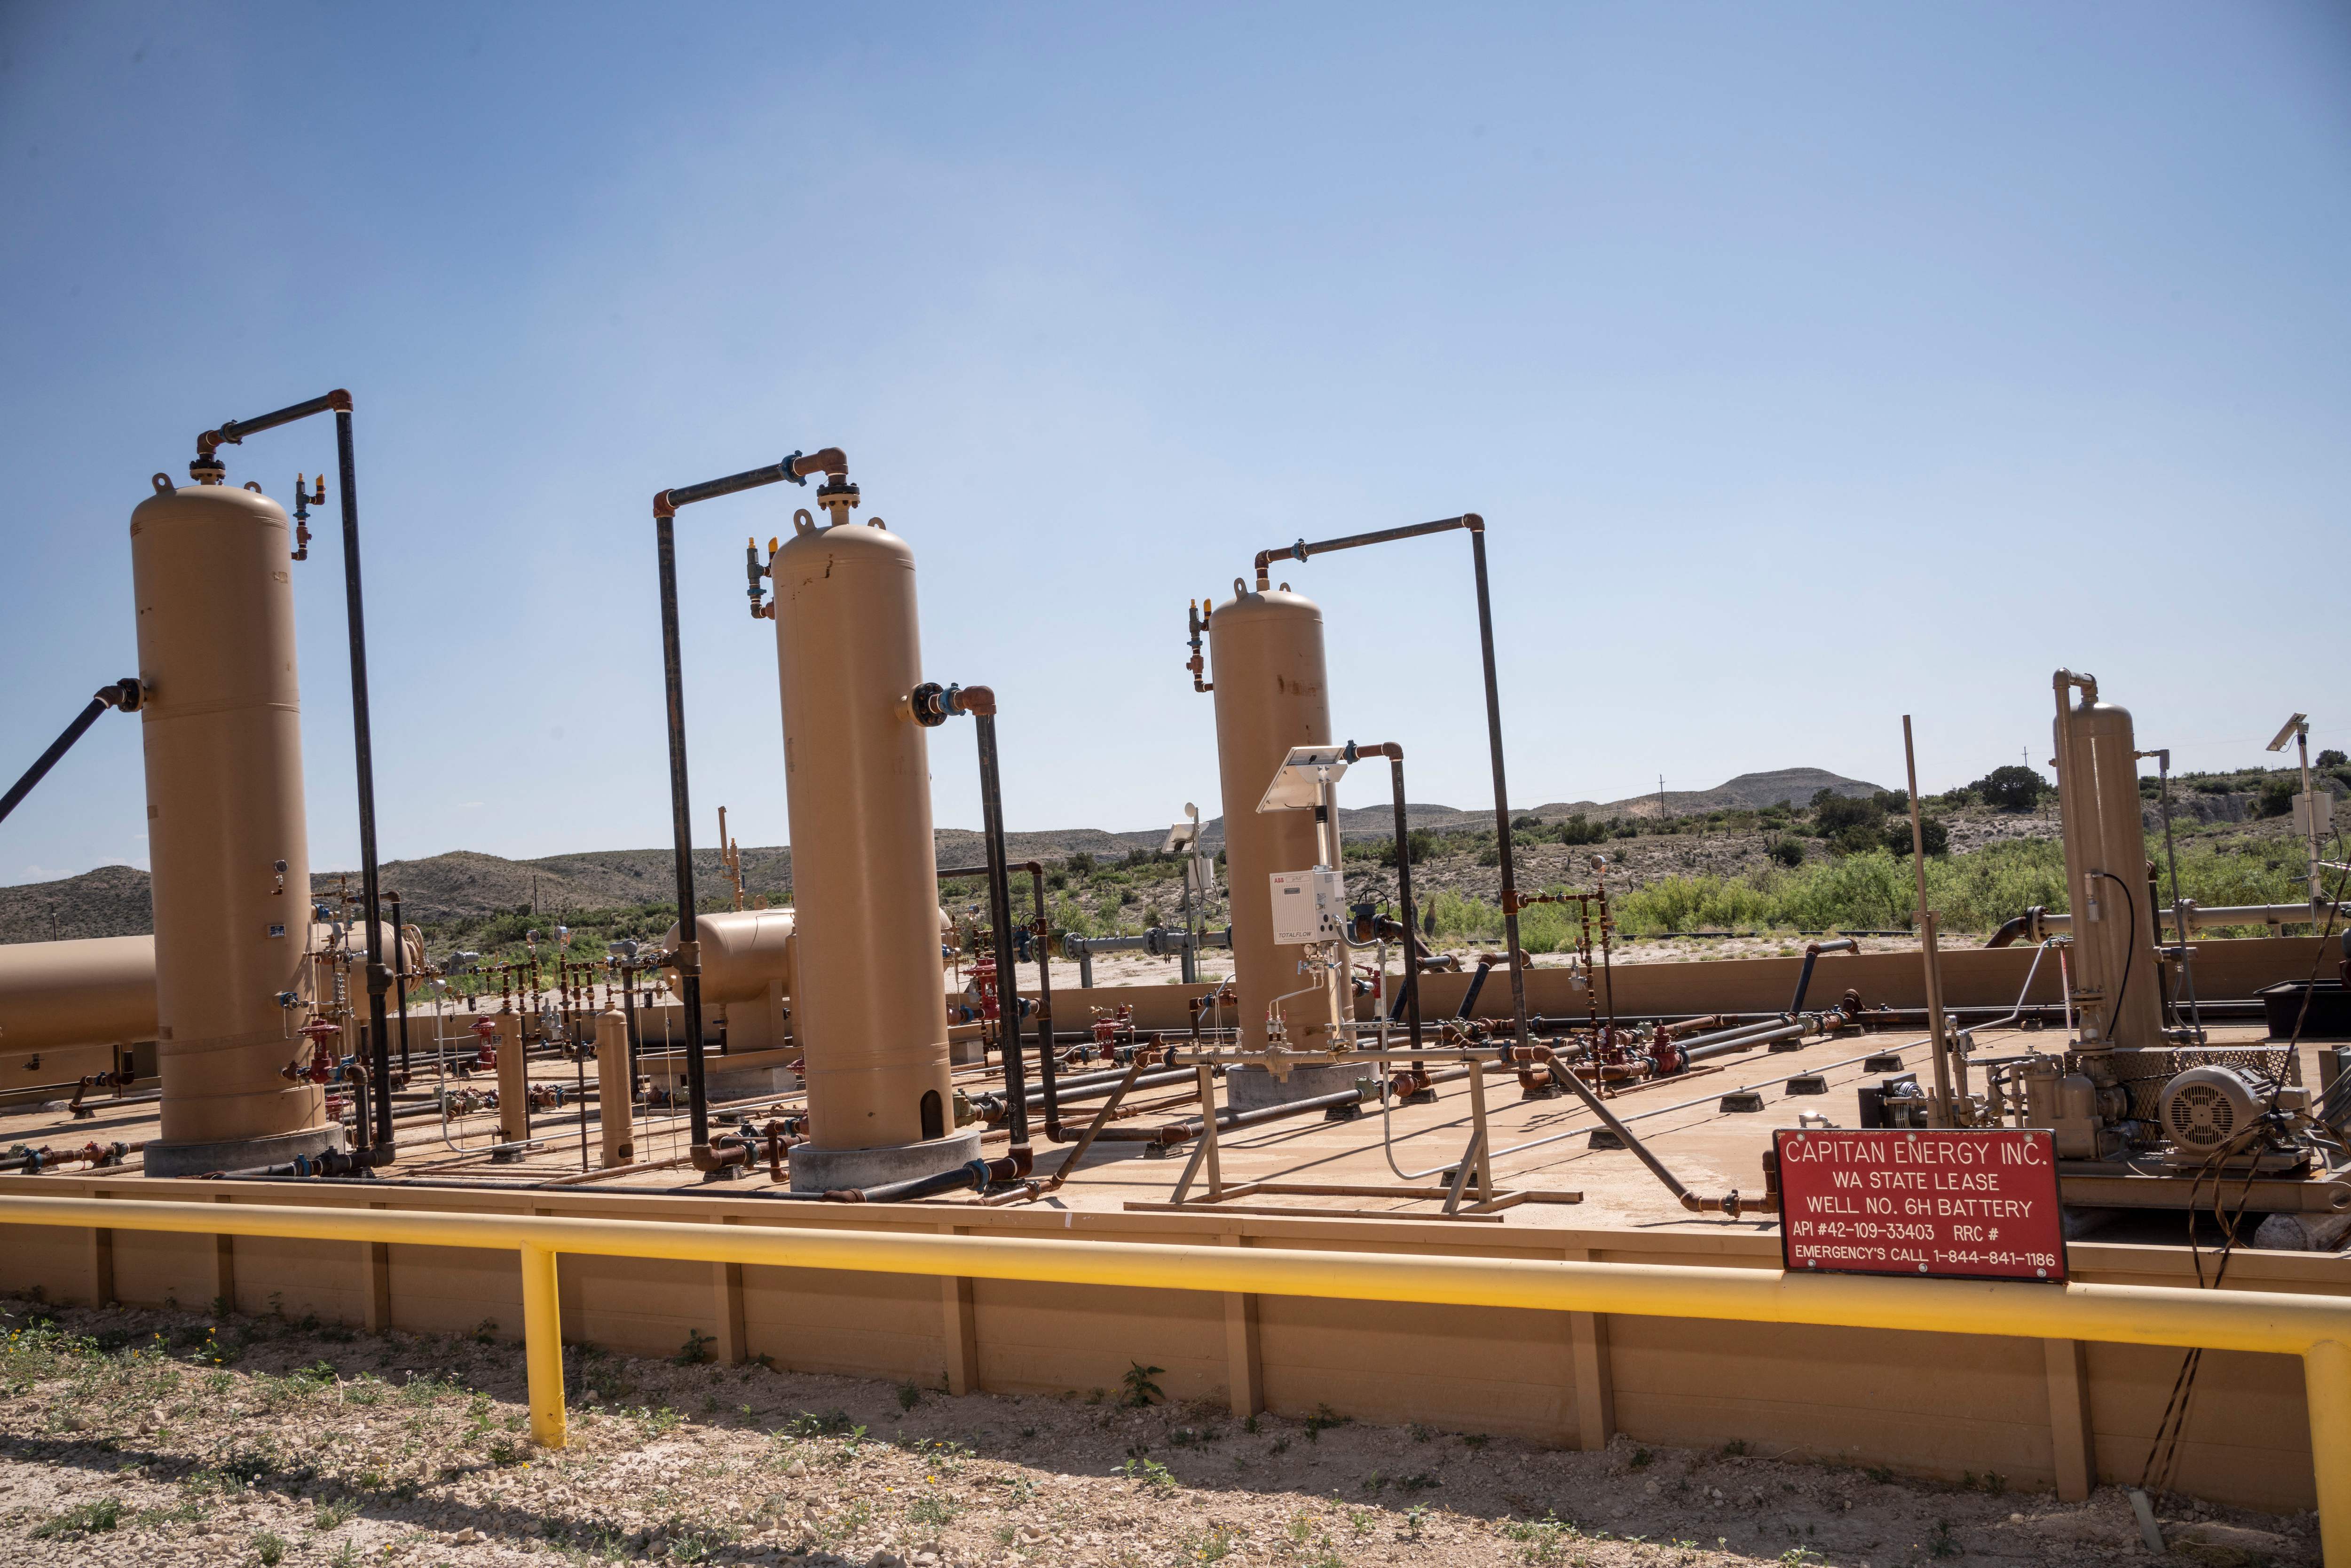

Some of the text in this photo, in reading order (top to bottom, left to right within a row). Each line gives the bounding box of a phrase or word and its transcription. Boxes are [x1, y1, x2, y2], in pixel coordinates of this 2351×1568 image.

[1786, 1141, 2047, 1165] CAPITAN ENERGY INC.
[1832, 1171, 2000, 1191] WA STATE LEASE
[1806, 1196, 2032, 1218] WELL NO. 6H BATTERY
[1793, 1221, 1999, 1242] API #42-109-33403 RRC #
[1795, 1245, 2055, 1267] EMERGENCY'S CALL 1-844-841-1186
